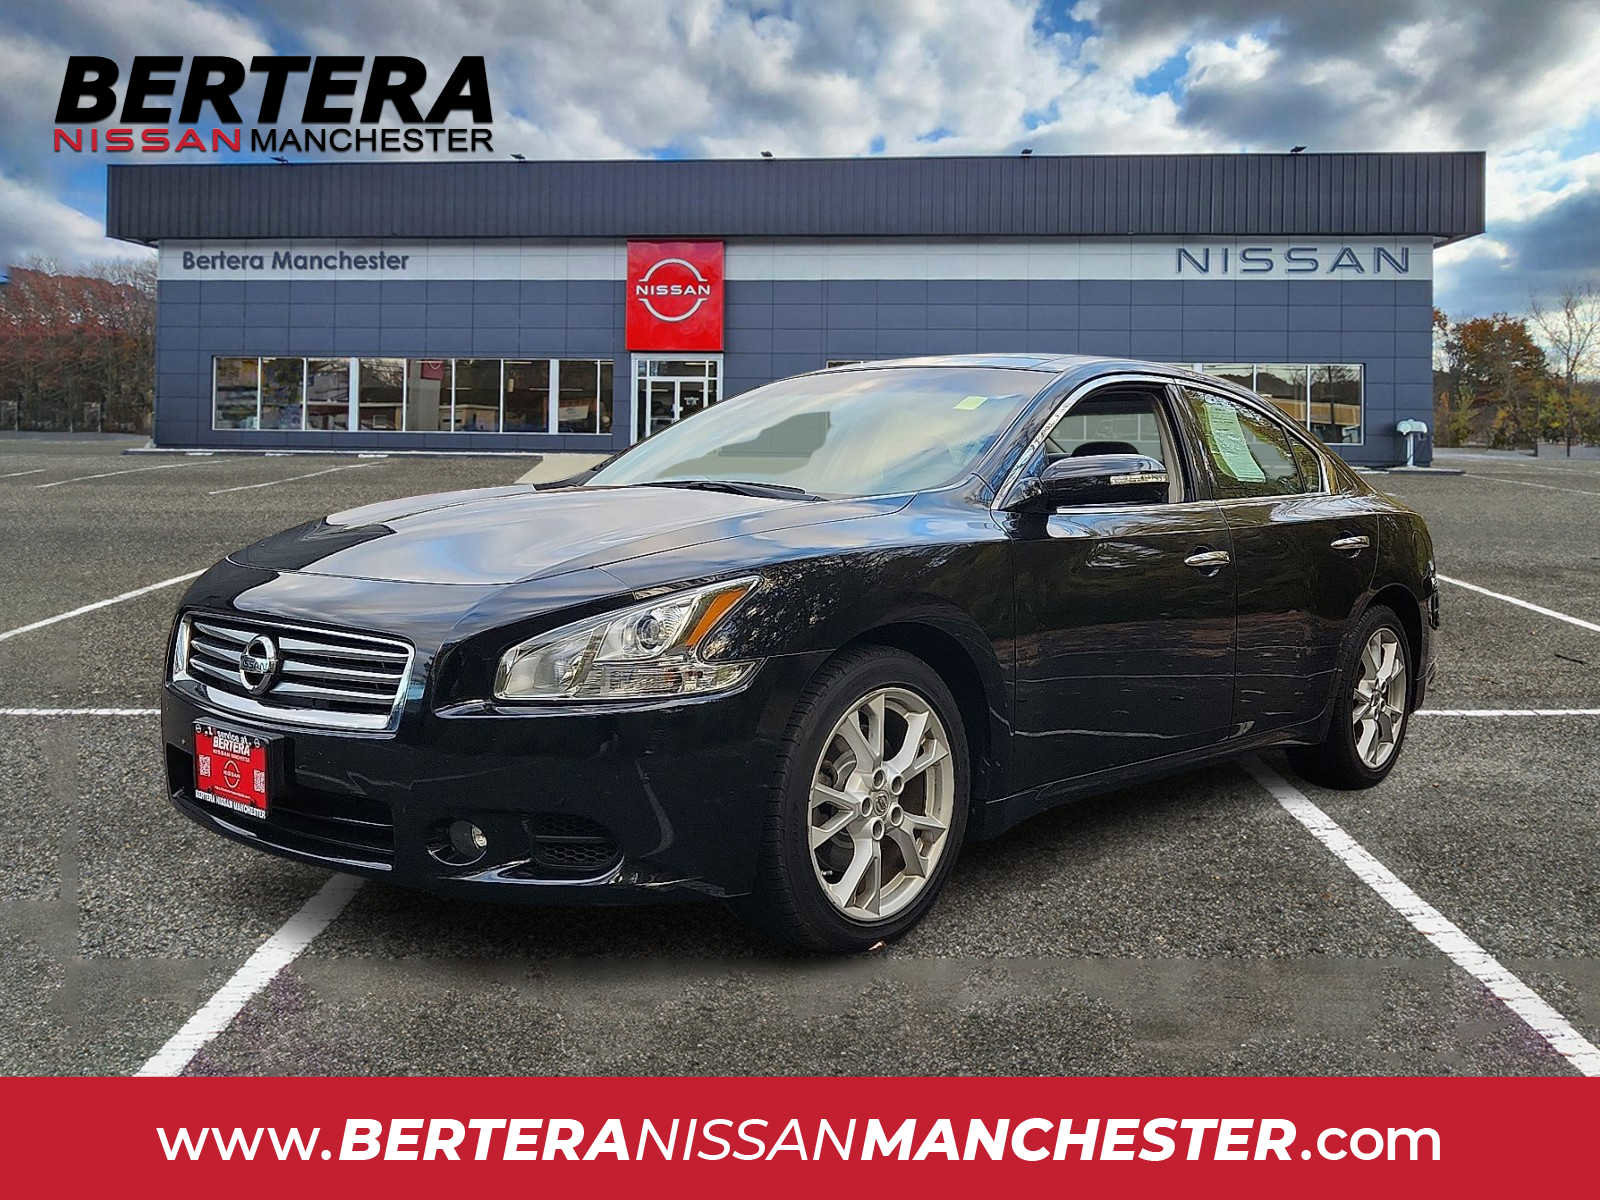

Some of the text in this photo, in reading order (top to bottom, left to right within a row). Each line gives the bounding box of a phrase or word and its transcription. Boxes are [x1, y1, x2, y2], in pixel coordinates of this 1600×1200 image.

[182, 251, 409, 270] Bertera Manchester
[1176, 247, 1410, 274] NISSAN
[636, 285, 711, 296] NISSAN
[213, 736, 250, 757] BERTERA
